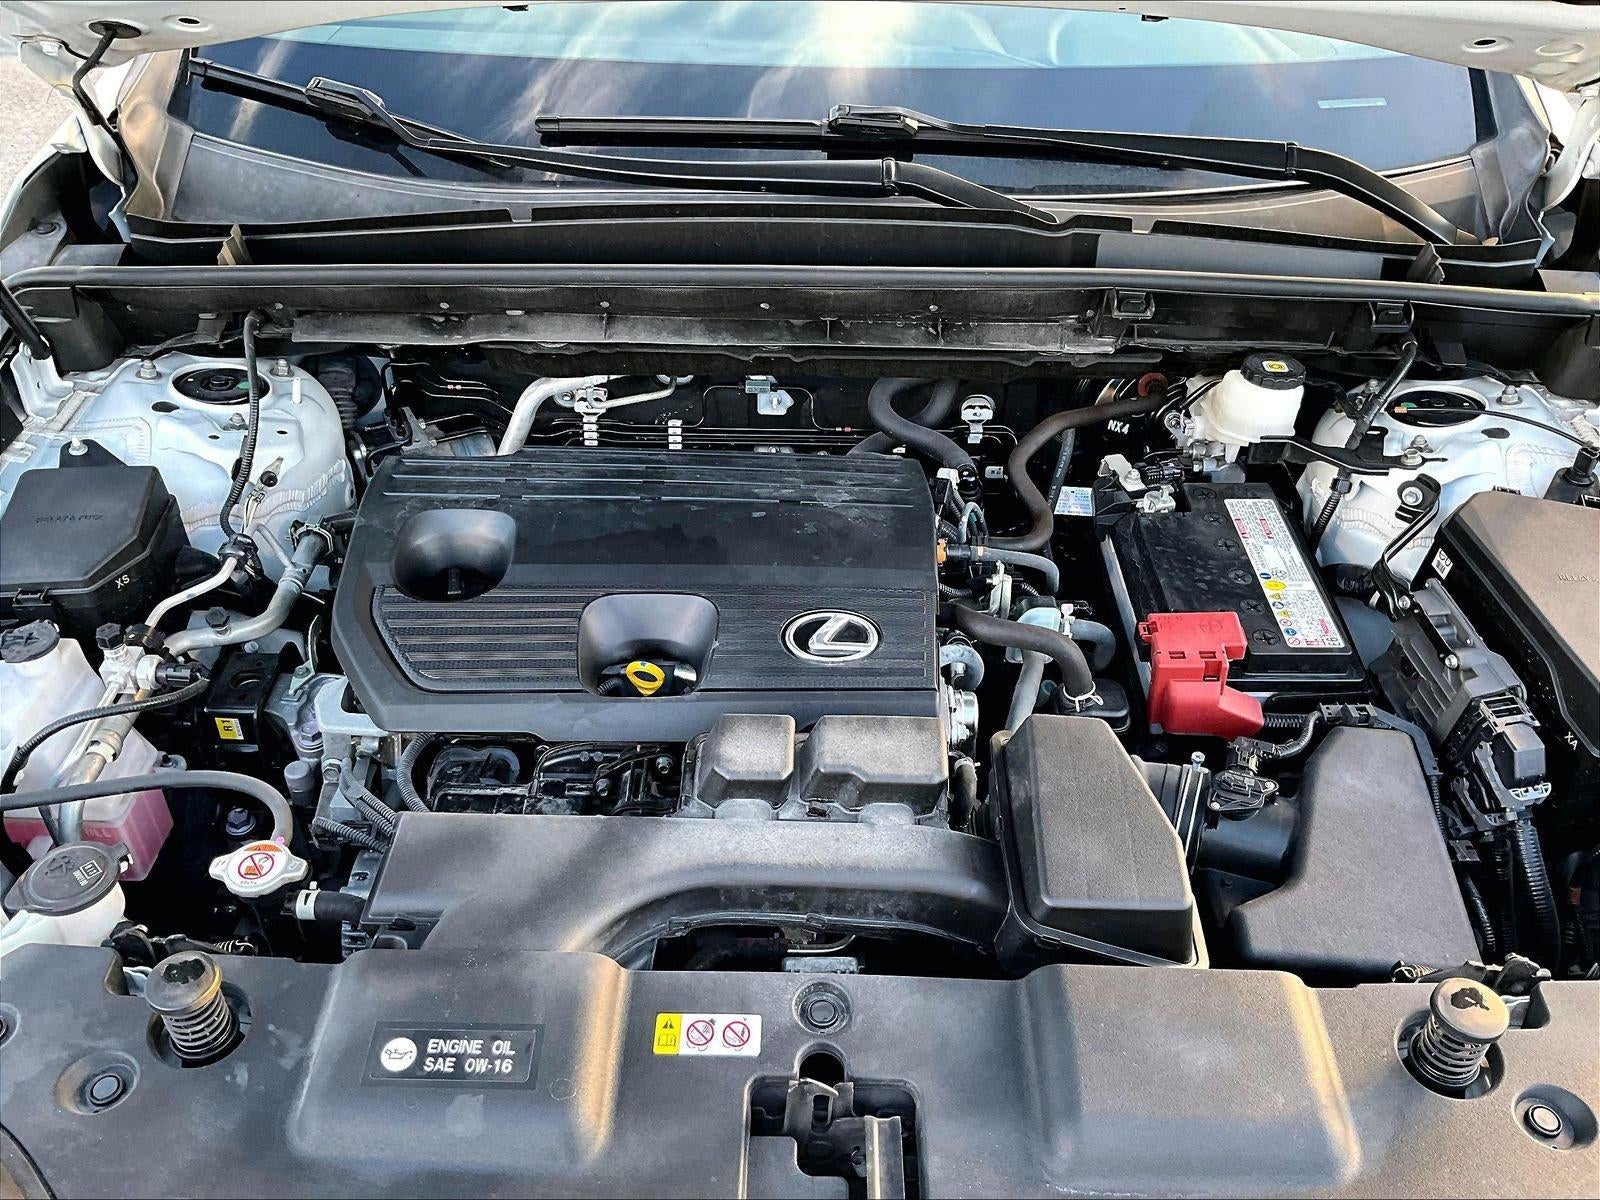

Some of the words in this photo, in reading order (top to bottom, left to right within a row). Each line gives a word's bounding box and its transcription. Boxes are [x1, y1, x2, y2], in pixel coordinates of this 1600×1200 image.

[1107, 419, 1130, 435] NX4
[115, 574, 130, 590] XS
[1564, 731, 1578, 751] XA
[427, 1038, 484, 1055] ENGINE
[491, 1039, 516, 1056] OIL
[423, 1056, 457, 1073] SAE
[464, 1058, 514, 1074] 0W-16
